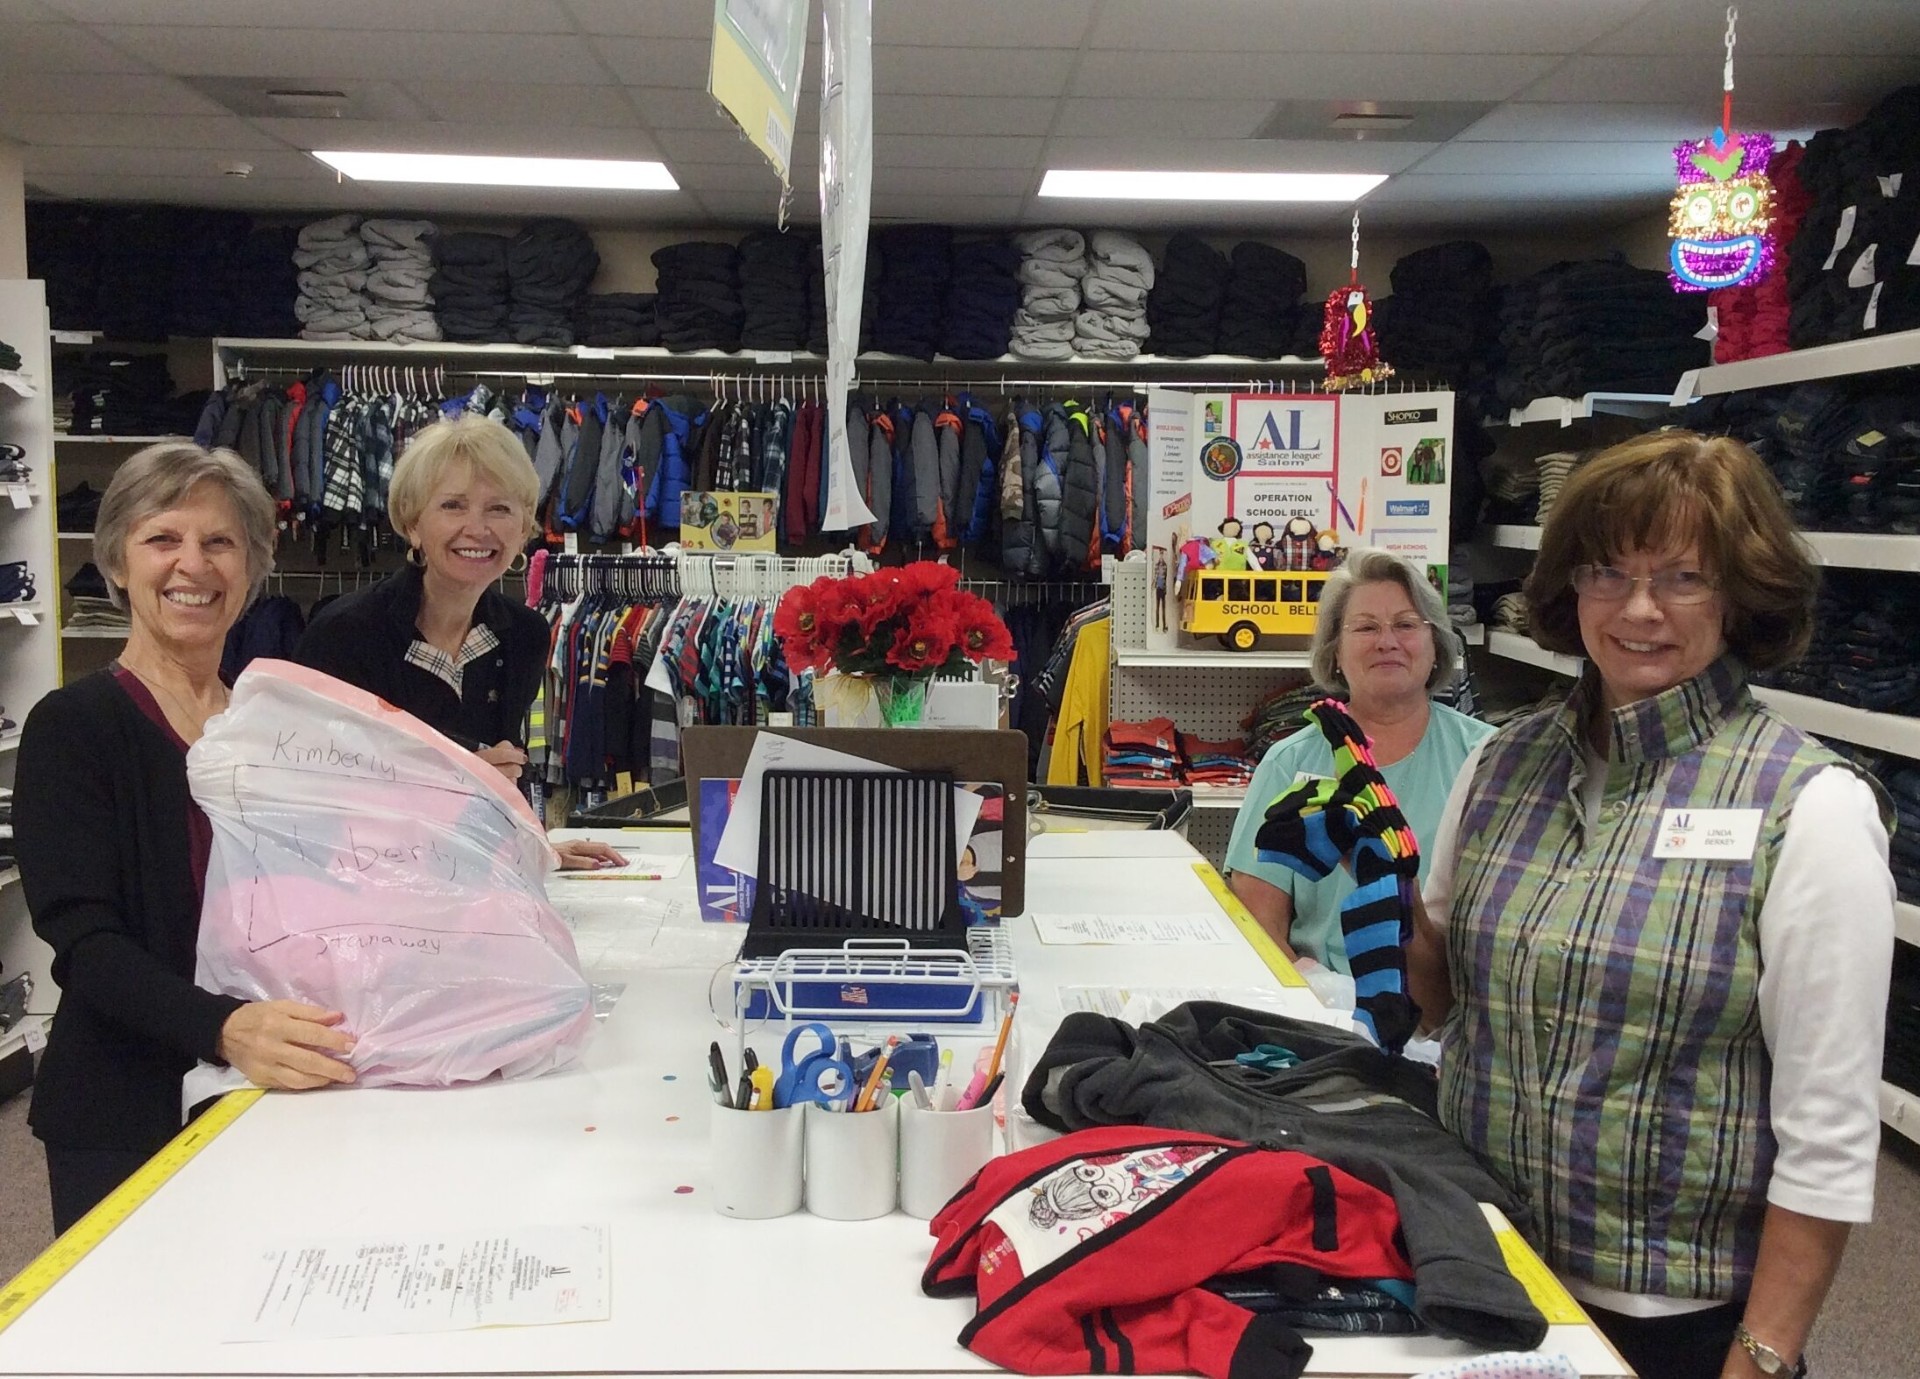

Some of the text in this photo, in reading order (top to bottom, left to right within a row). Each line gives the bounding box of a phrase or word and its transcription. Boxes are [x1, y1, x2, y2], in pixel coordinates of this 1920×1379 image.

[1247, 409, 1321, 451] AL
[1246, 450, 1321, 462] assistance league
[1253, 494, 1312, 502] OPERATION
[1246, 508, 1287, 517] SCHOOL
[1389, 503, 1418, 514] Walmart
[1222, 604, 1319, 616] SCHOOL BELL
[272, 730, 397, 782] Kimberly
[706, 871, 739, 916] AL
